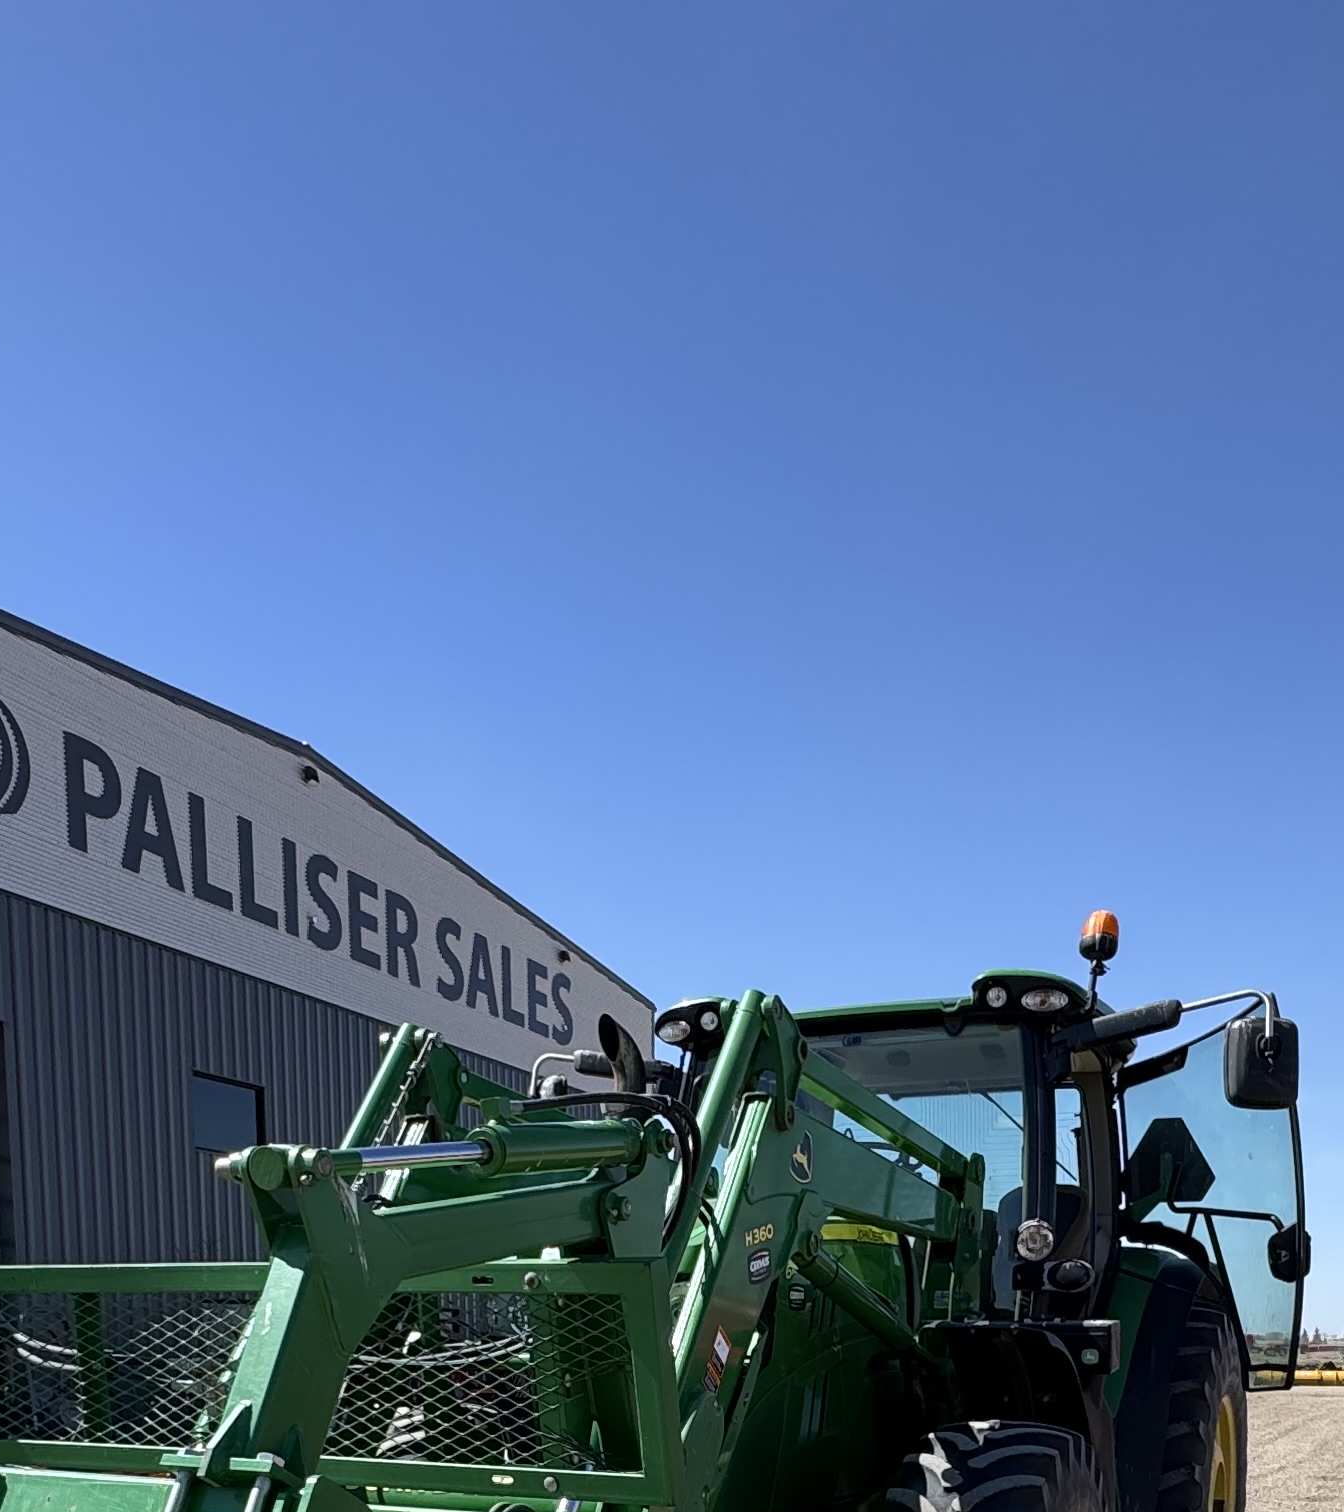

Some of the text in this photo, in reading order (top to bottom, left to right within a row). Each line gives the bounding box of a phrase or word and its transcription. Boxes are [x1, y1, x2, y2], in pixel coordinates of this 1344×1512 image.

[62, 730, 574, 1047] PALLISER SALES
[744, 1223, 774, 1248] H360
